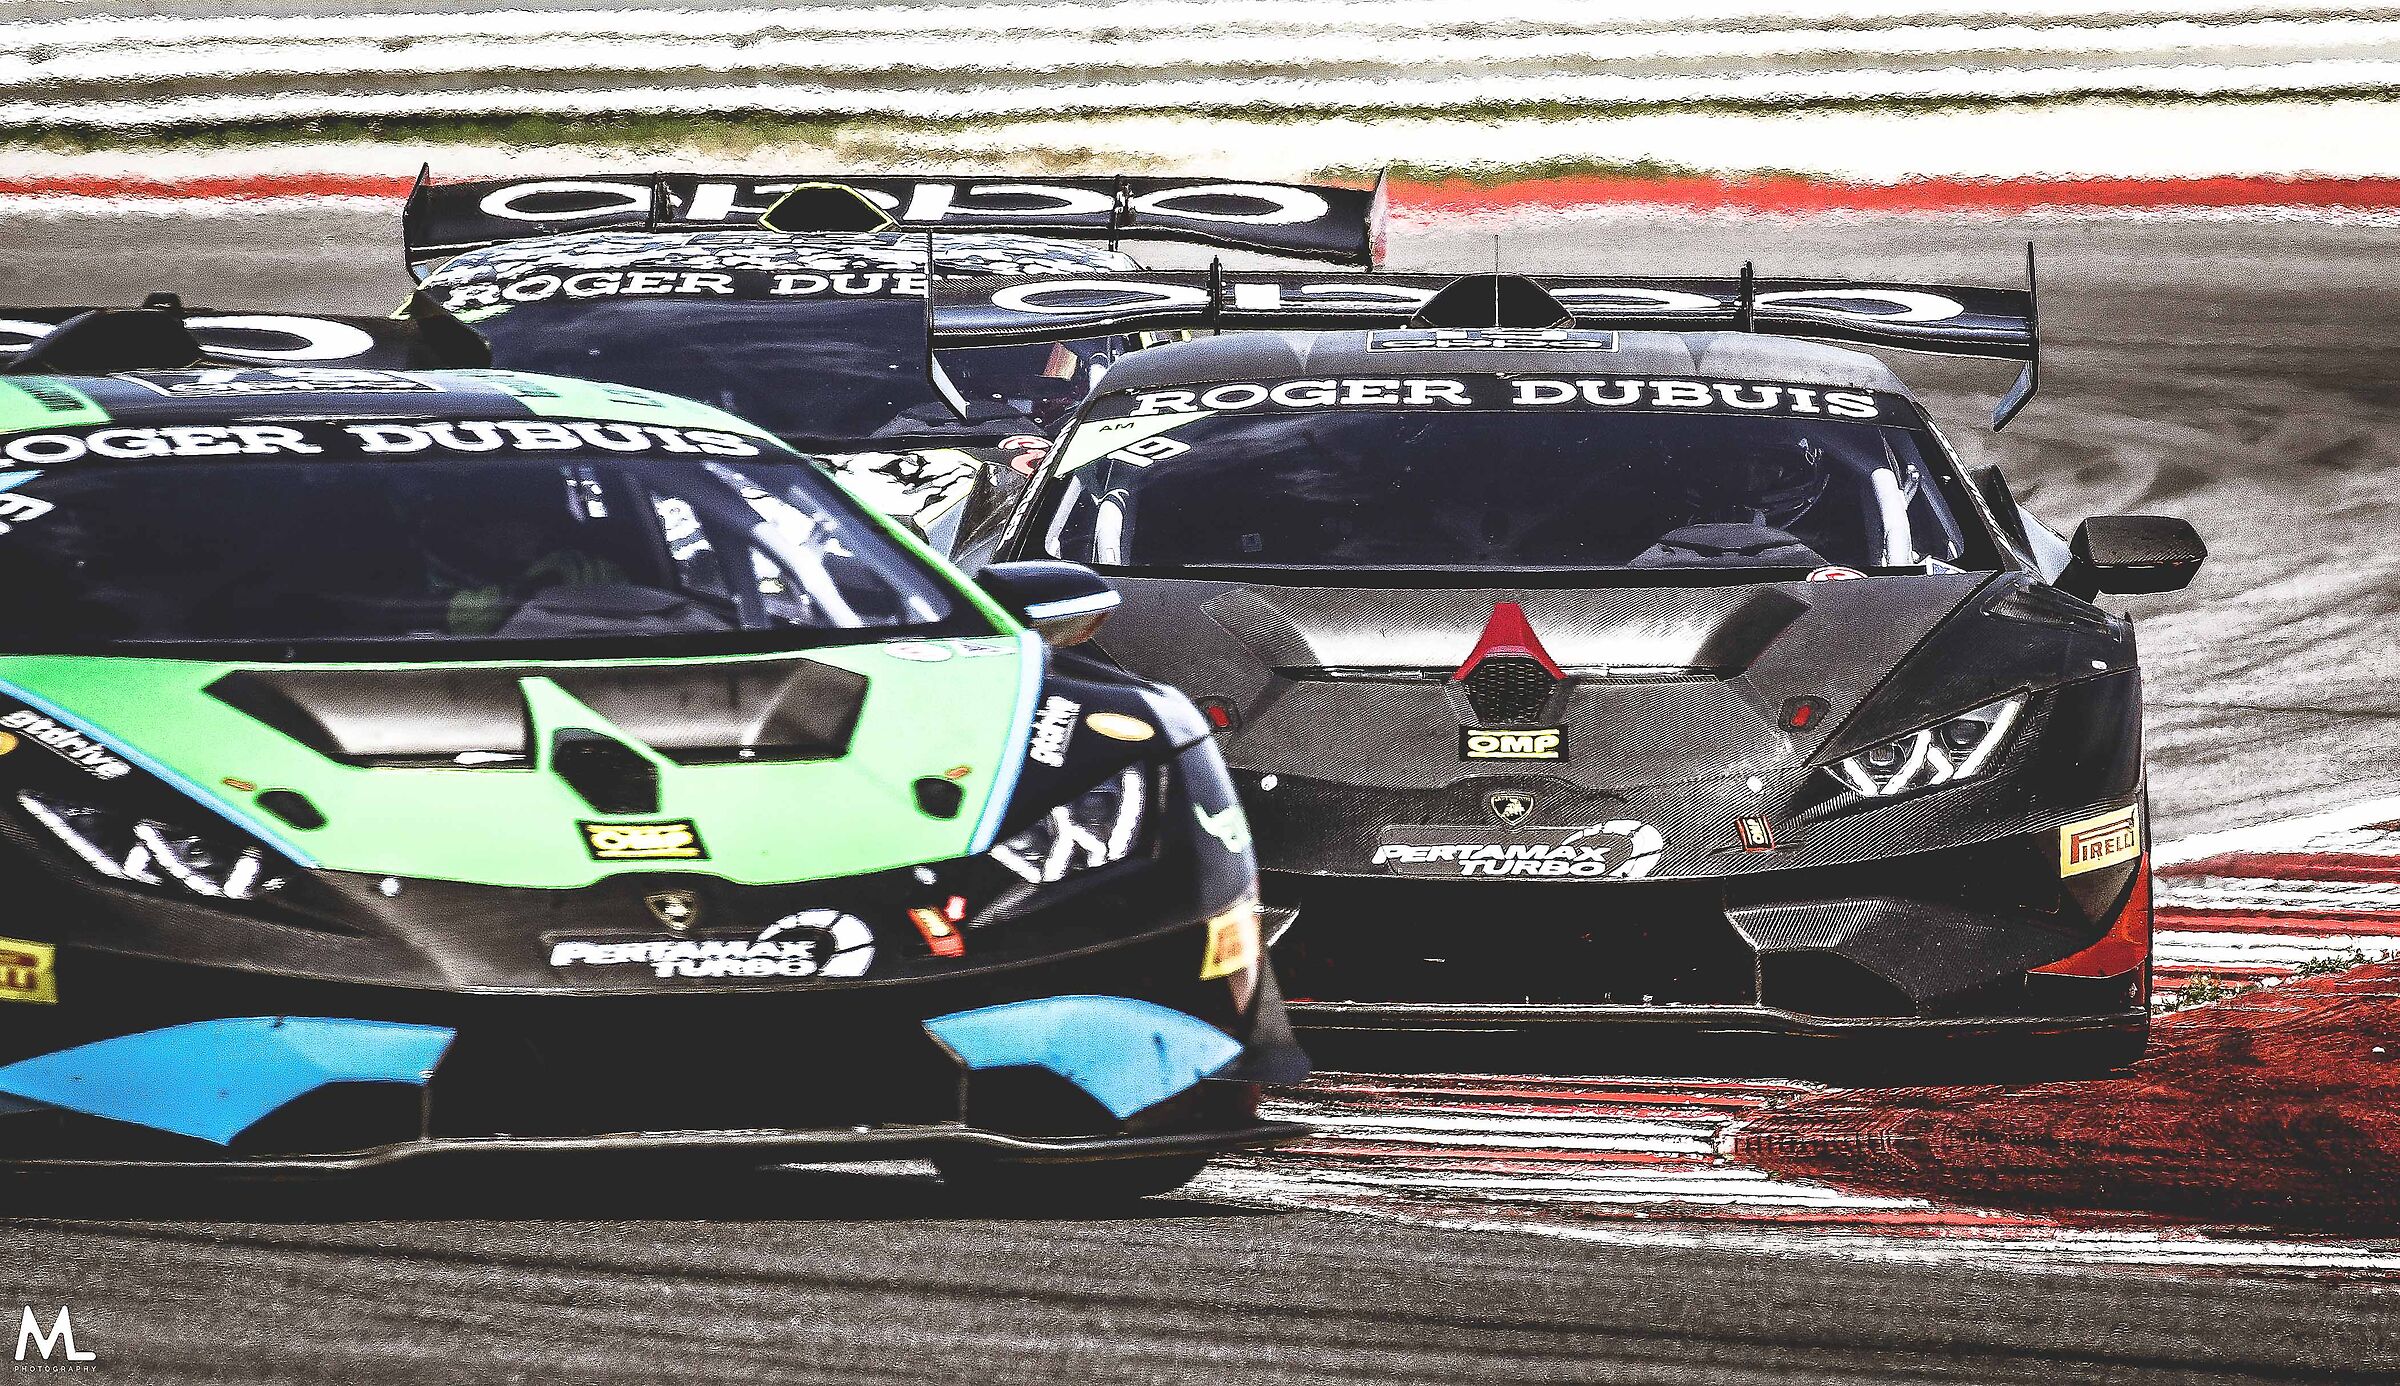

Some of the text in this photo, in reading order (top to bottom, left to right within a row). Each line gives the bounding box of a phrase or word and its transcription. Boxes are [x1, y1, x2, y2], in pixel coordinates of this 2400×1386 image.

[441, 273, 735, 313] ROGER
[1130, 379, 1879, 418] ROGER DUBUIS
[0, 420, 760, 467] OGER DUBUIS
[1467, 735, 1560, 753] OMP
[2070, 815, 2135, 865] PIRELLI
[1371, 844, 1612, 864] PERTAMAX
[1459, 860, 1607, 877] TURBO
[550, 941, 817, 966] PERTAMAX
[651, 958, 818, 977] TURBO
